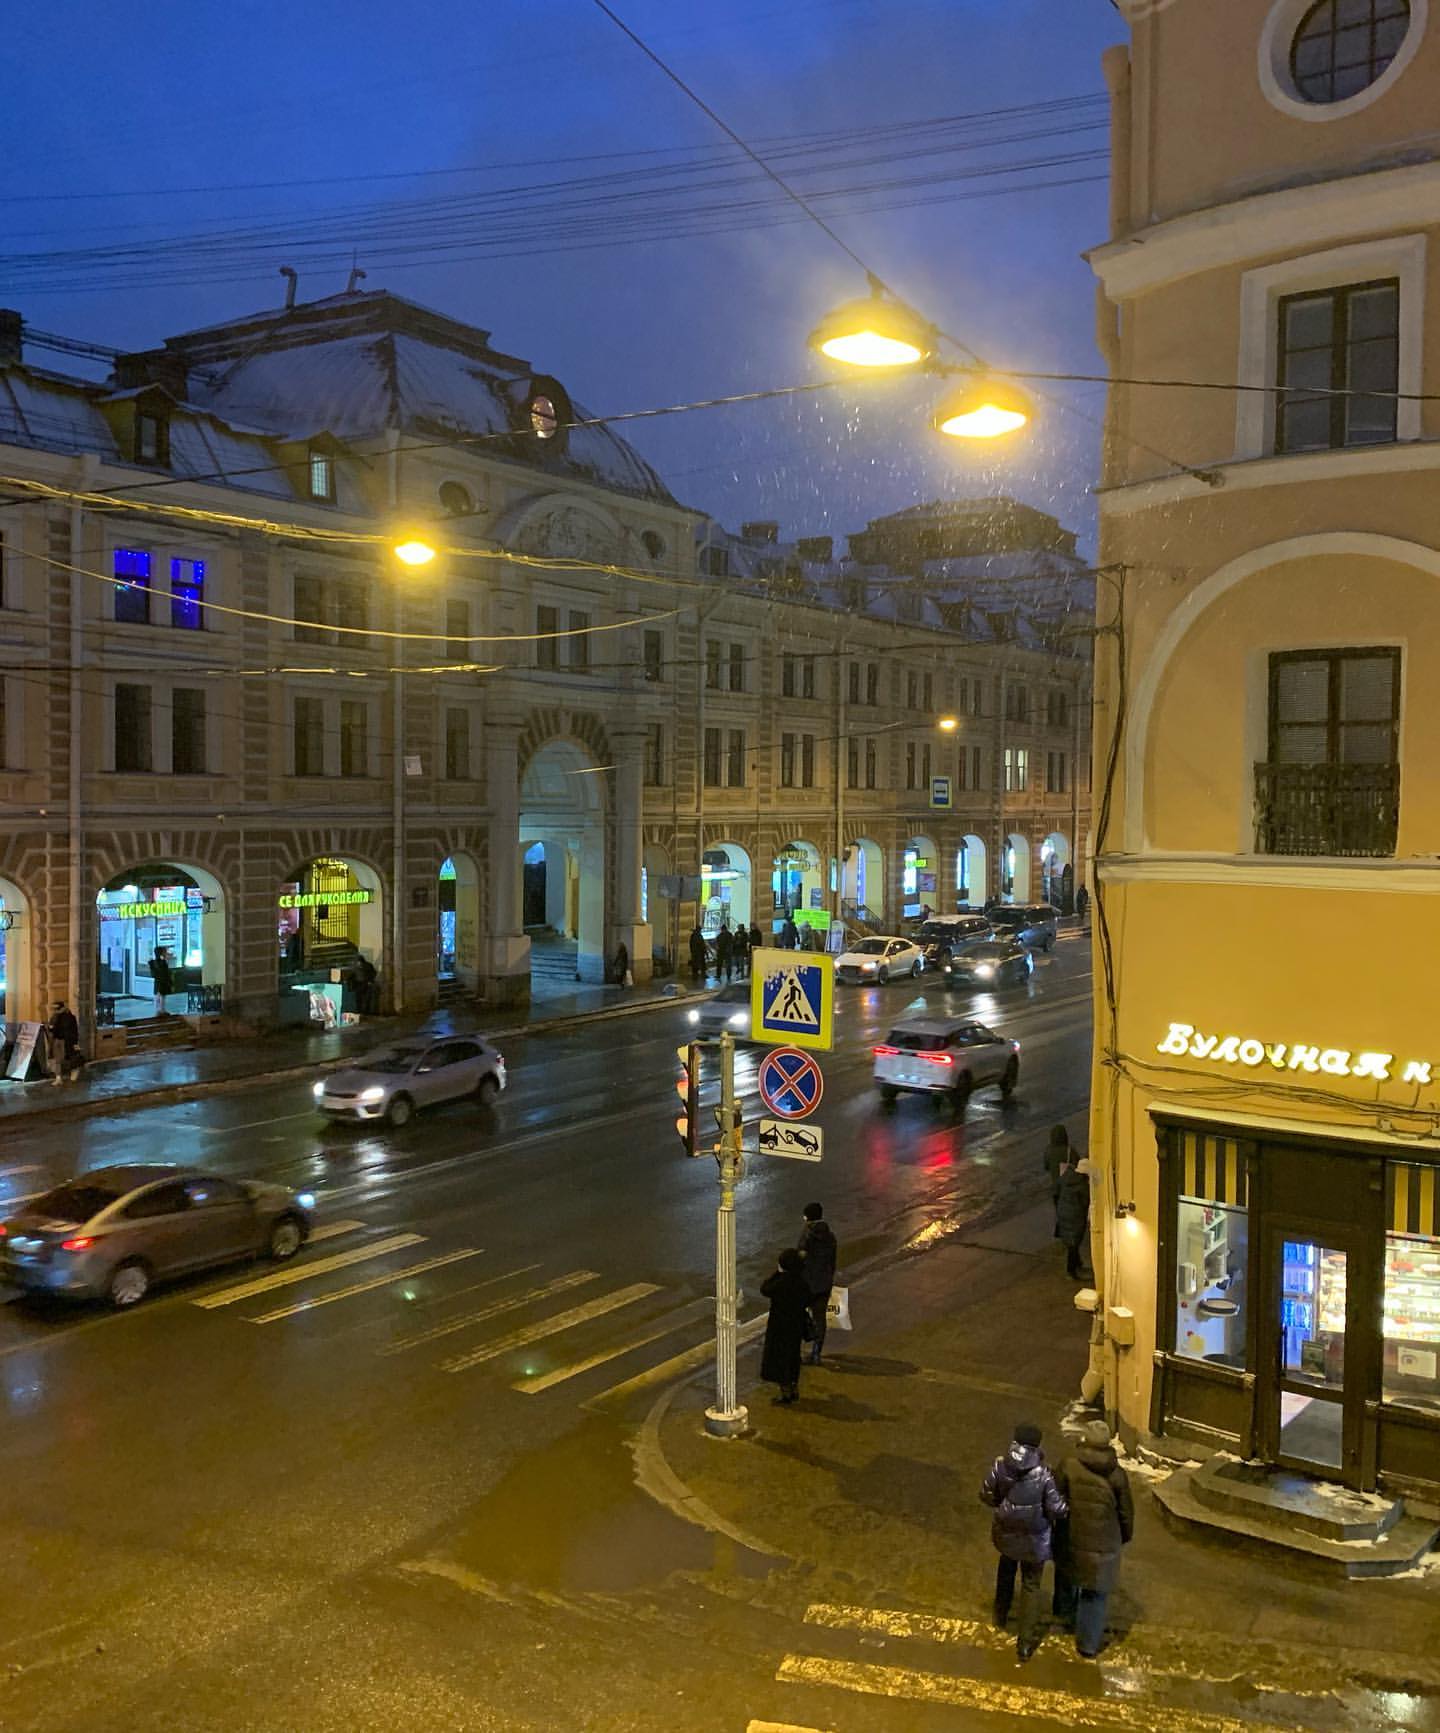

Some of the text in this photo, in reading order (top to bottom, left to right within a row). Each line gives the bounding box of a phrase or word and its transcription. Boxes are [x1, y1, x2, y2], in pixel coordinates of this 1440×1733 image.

[279, 890, 369, 908] СЕ ДЛЯ РУКОДЕЛИЯ
[119, 900, 187, 919] ИСКУСНИЦА
[1157, 1022, 1393, 1080] Булочная
